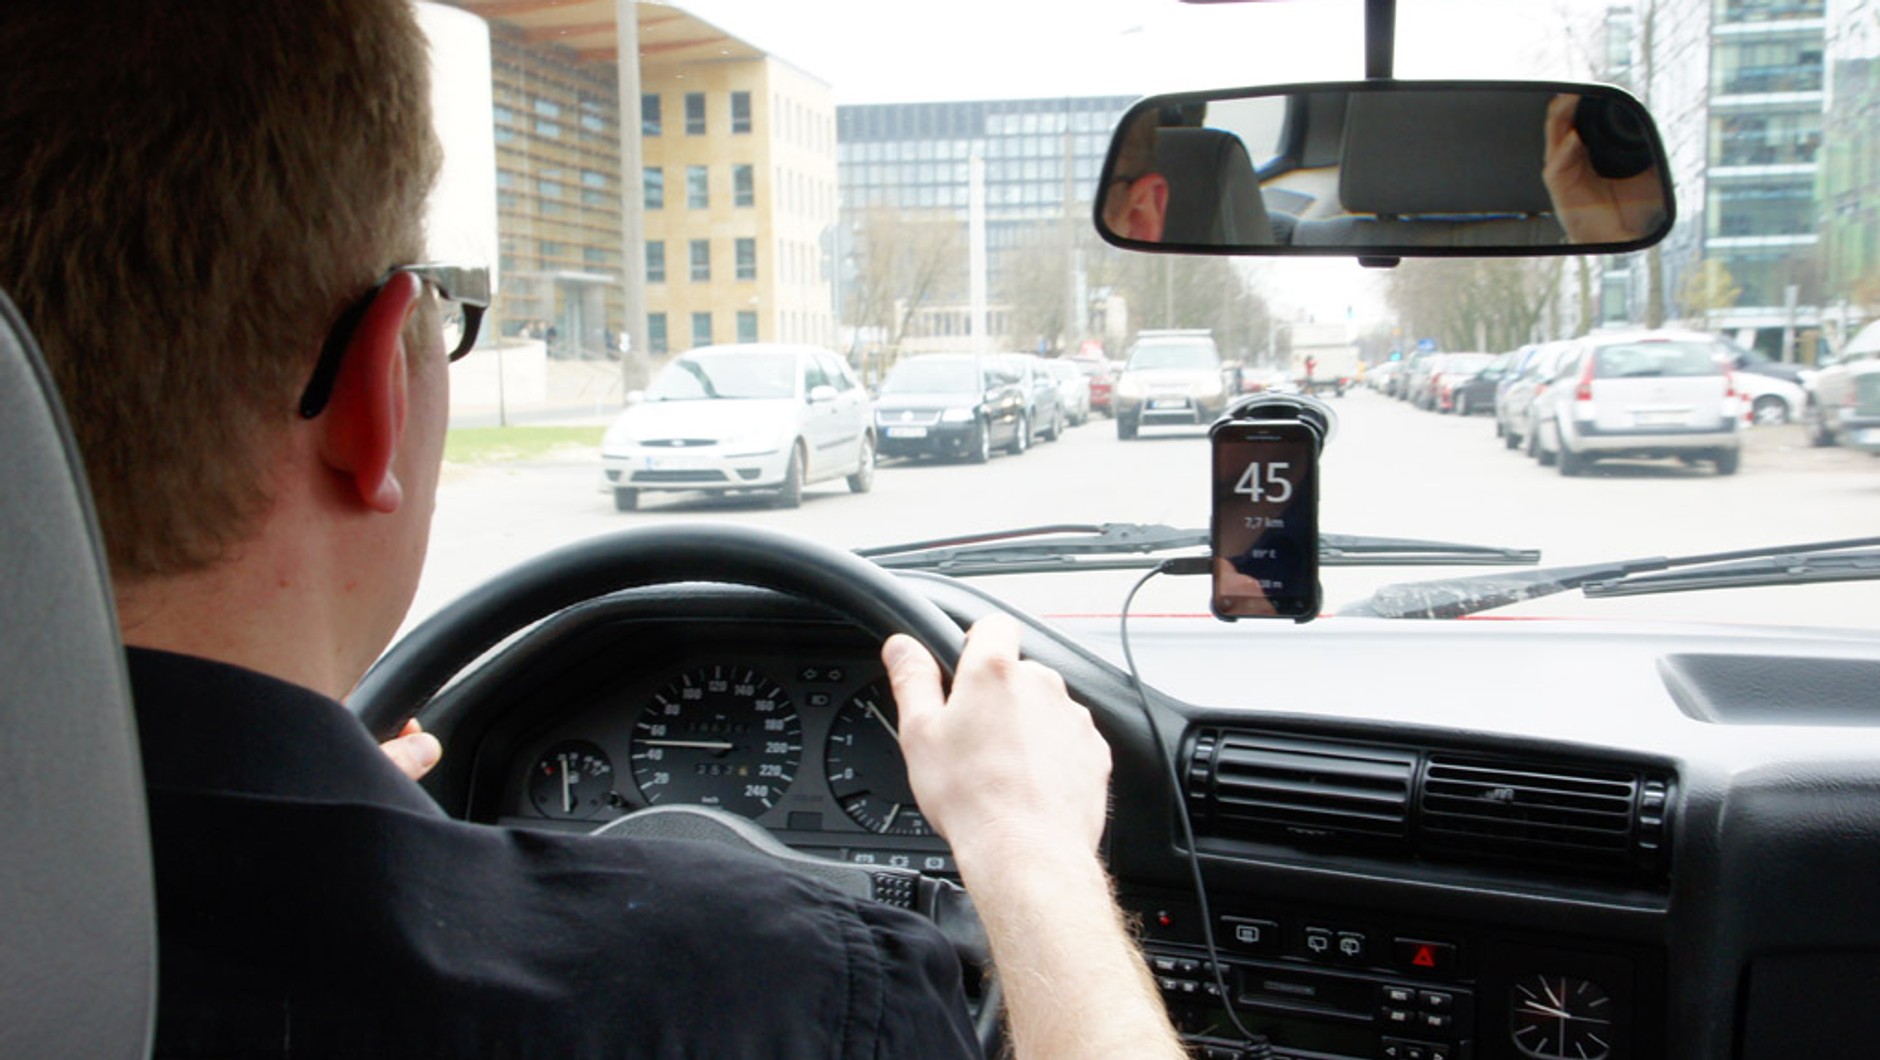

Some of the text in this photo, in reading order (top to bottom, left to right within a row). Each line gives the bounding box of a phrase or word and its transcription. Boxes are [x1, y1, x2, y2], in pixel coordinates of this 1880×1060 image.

[1234, 462, 1293, 503] 45
[1265, 517, 1284, 528] km
[708, 680, 727, 692] 120
[734, 684, 755, 696] 140
[682, 688, 702, 700] 100
[664, 704, 681, 715] 80
[755, 700, 775, 711] 160
[650, 724, 667, 736] 60
[764, 719, 784, 731] 180
[846, 734, 853, 746] 1
[646, 748, 663, 760] 40
[765, 742, 788, 754] 200
[759, 764, 782, 776] 220
[844, 768, 853, 780] 0
[653, 772, 670, 784] 20
[744, 785, 768, 797] 240
